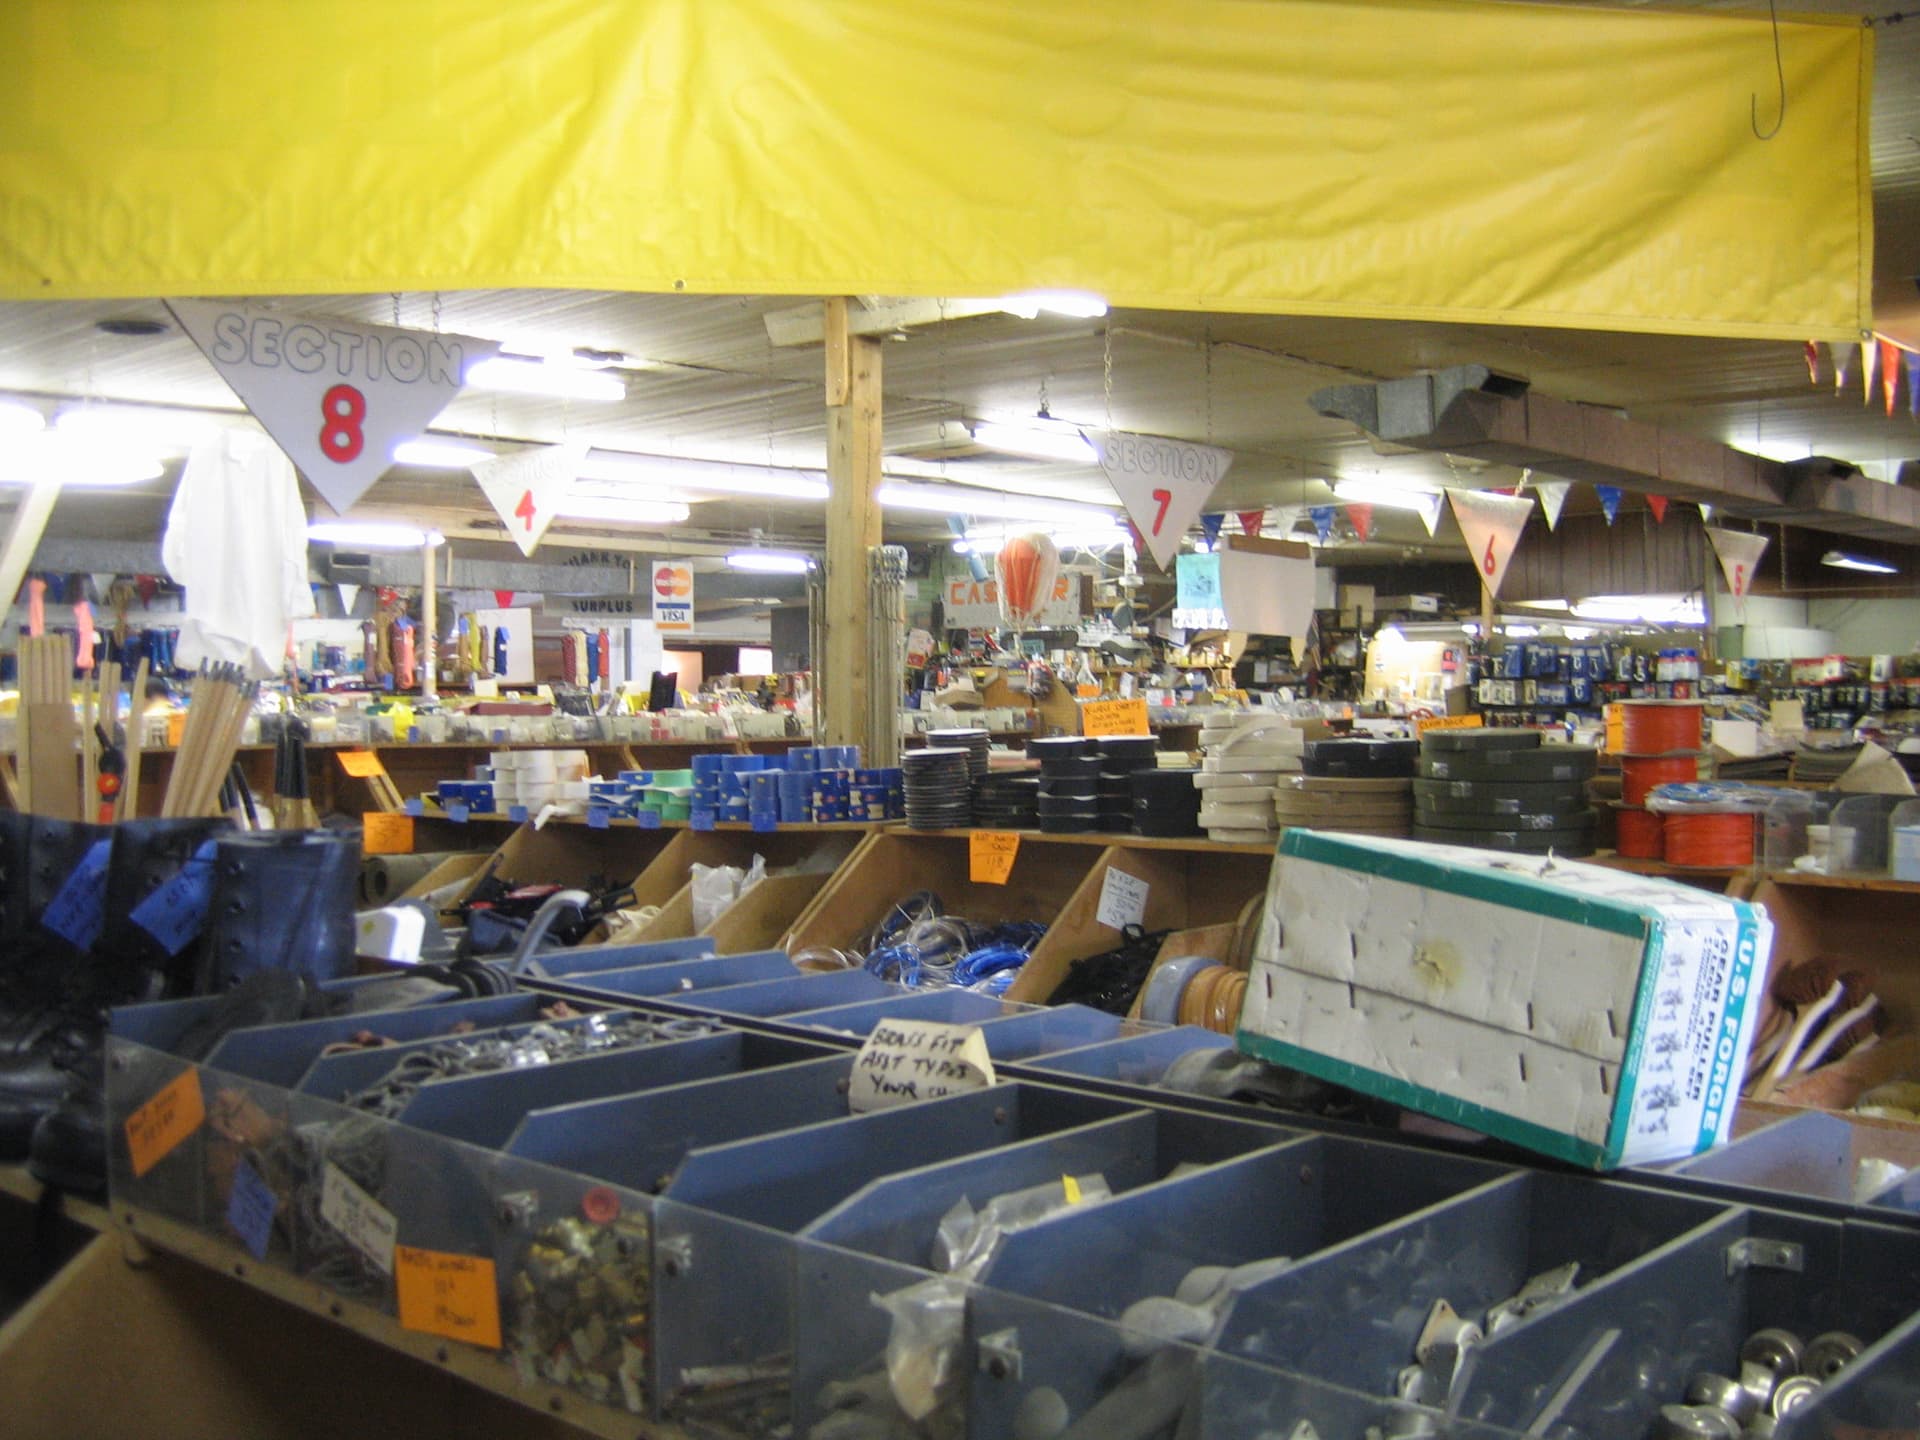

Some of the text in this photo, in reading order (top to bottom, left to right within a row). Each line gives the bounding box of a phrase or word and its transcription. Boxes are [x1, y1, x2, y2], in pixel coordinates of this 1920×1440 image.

[213, 313, 464, 387] SECTION
[319, 383, 367, 464] 8
[1103, 437, 1217, 485] SECTION
[514, 489, 537, 533] 4
[1152, 488, 1172, 537] 7
[1484, 534, 1496, 576] 6
[572, 600, 633, 613] SURPLUS
[951, 578, 1069, 605] CASR
[662, 610, 685, 622] VISA
[1711, 938, 1729, 1003] GEAR
[1692, 1010, 1716, 1101] PULLER
[1703, 939, 1754, 1131] U.S. FORGE
